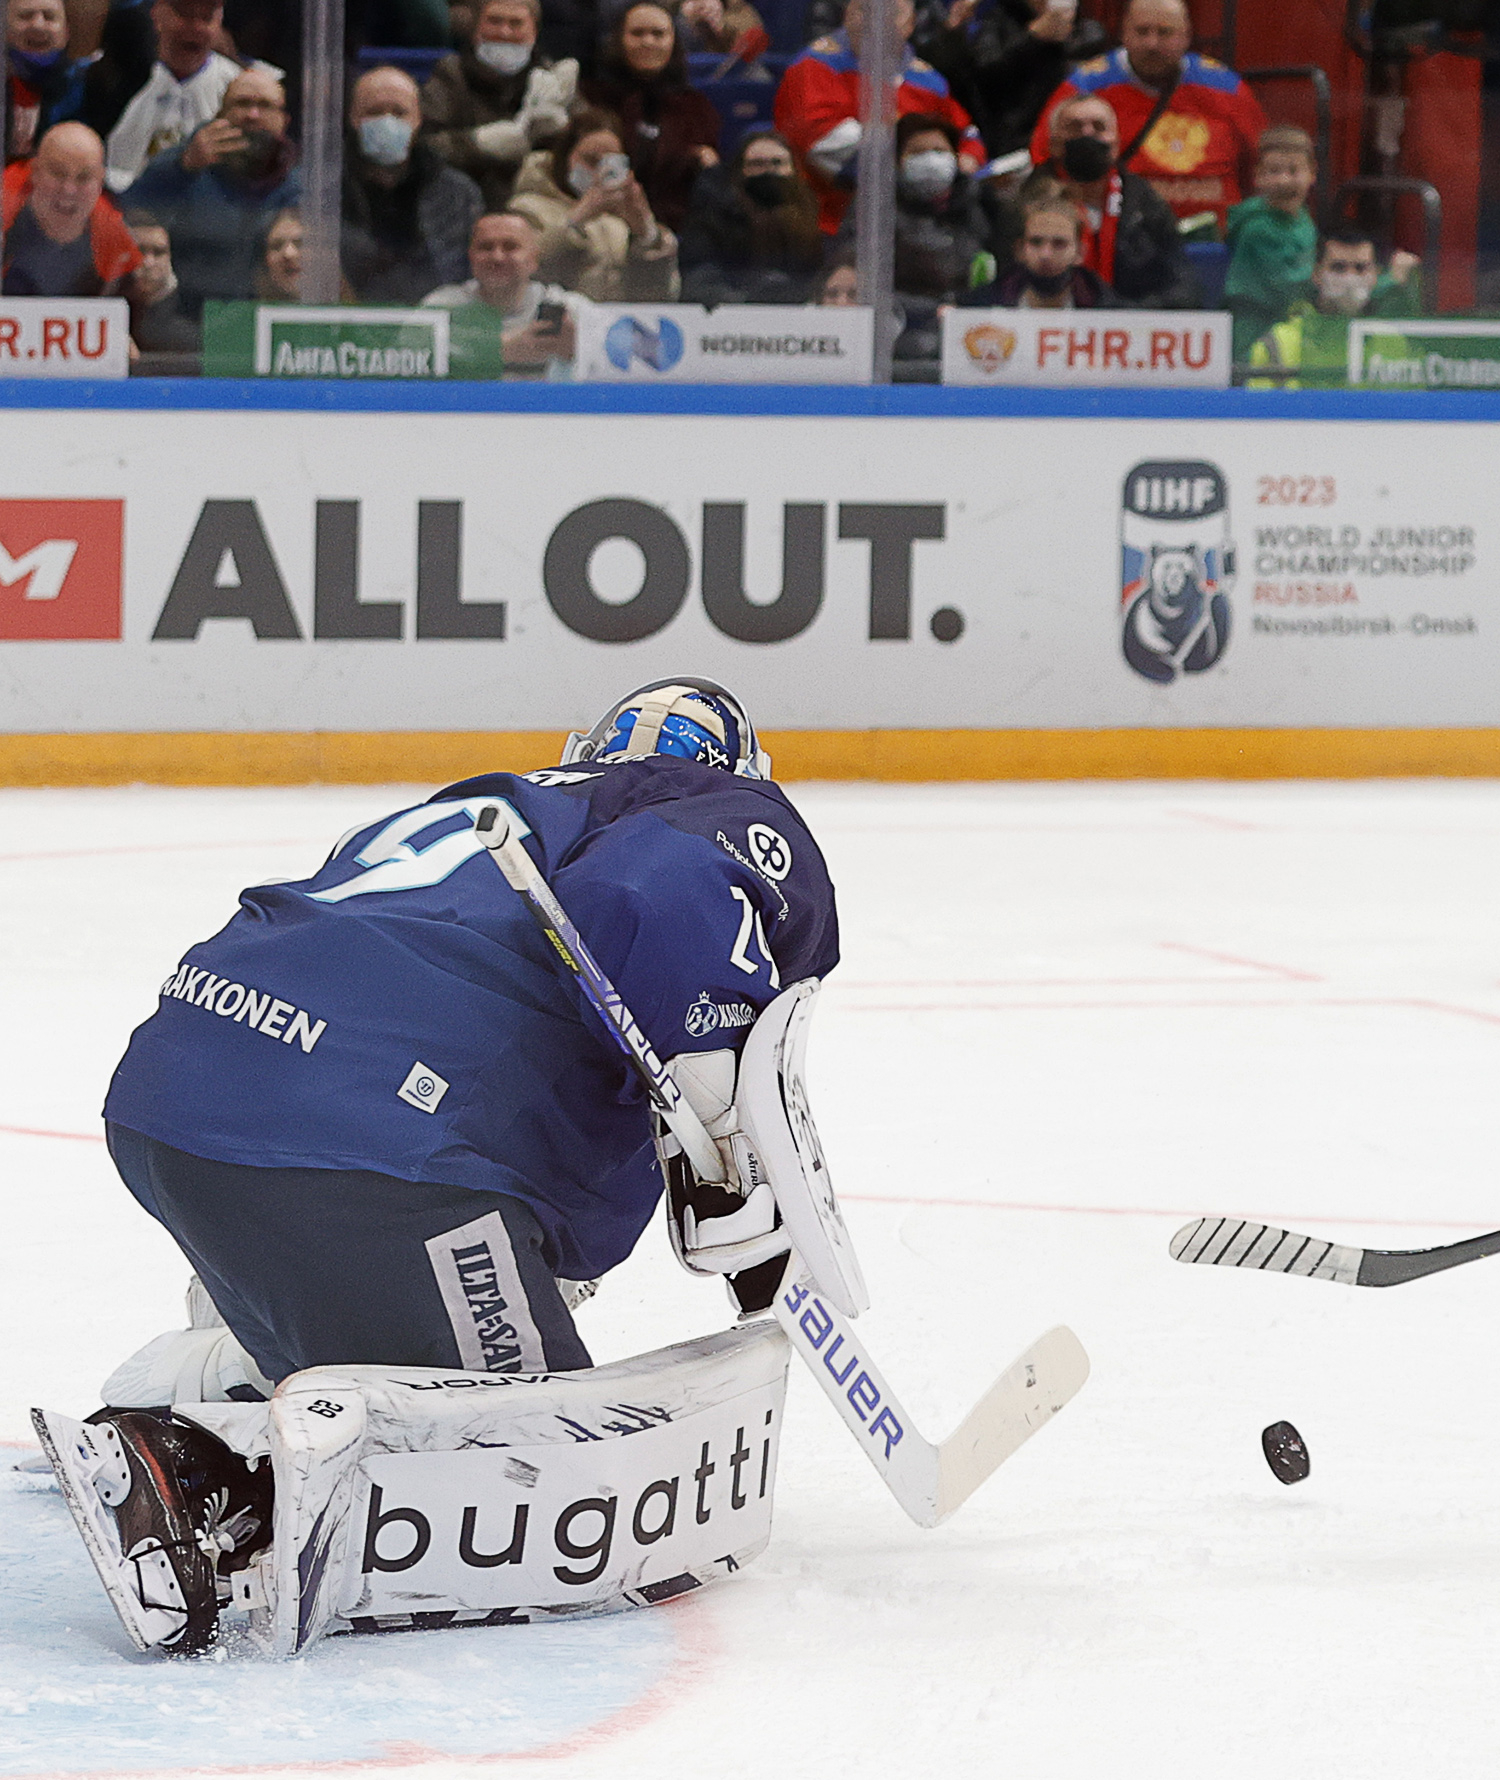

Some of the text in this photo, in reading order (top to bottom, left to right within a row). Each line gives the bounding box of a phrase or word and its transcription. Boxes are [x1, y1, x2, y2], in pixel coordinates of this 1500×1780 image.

[1036, 328, 1212, 370] FHR.RU
[1134, 475, 1219, 512] IIHF
[1254, 475, 1338, 507] 2023
[1254, 525, 1477, 550] WORLD JUNIOR
[151, 495, 965, 645] ALL OUT.
[1254, 551, 1477, 576] CHAMPIONSHIP
[1253, 582, 1359, 606] RUSSIA
[361, 1409, 773, 1587] bugatti
